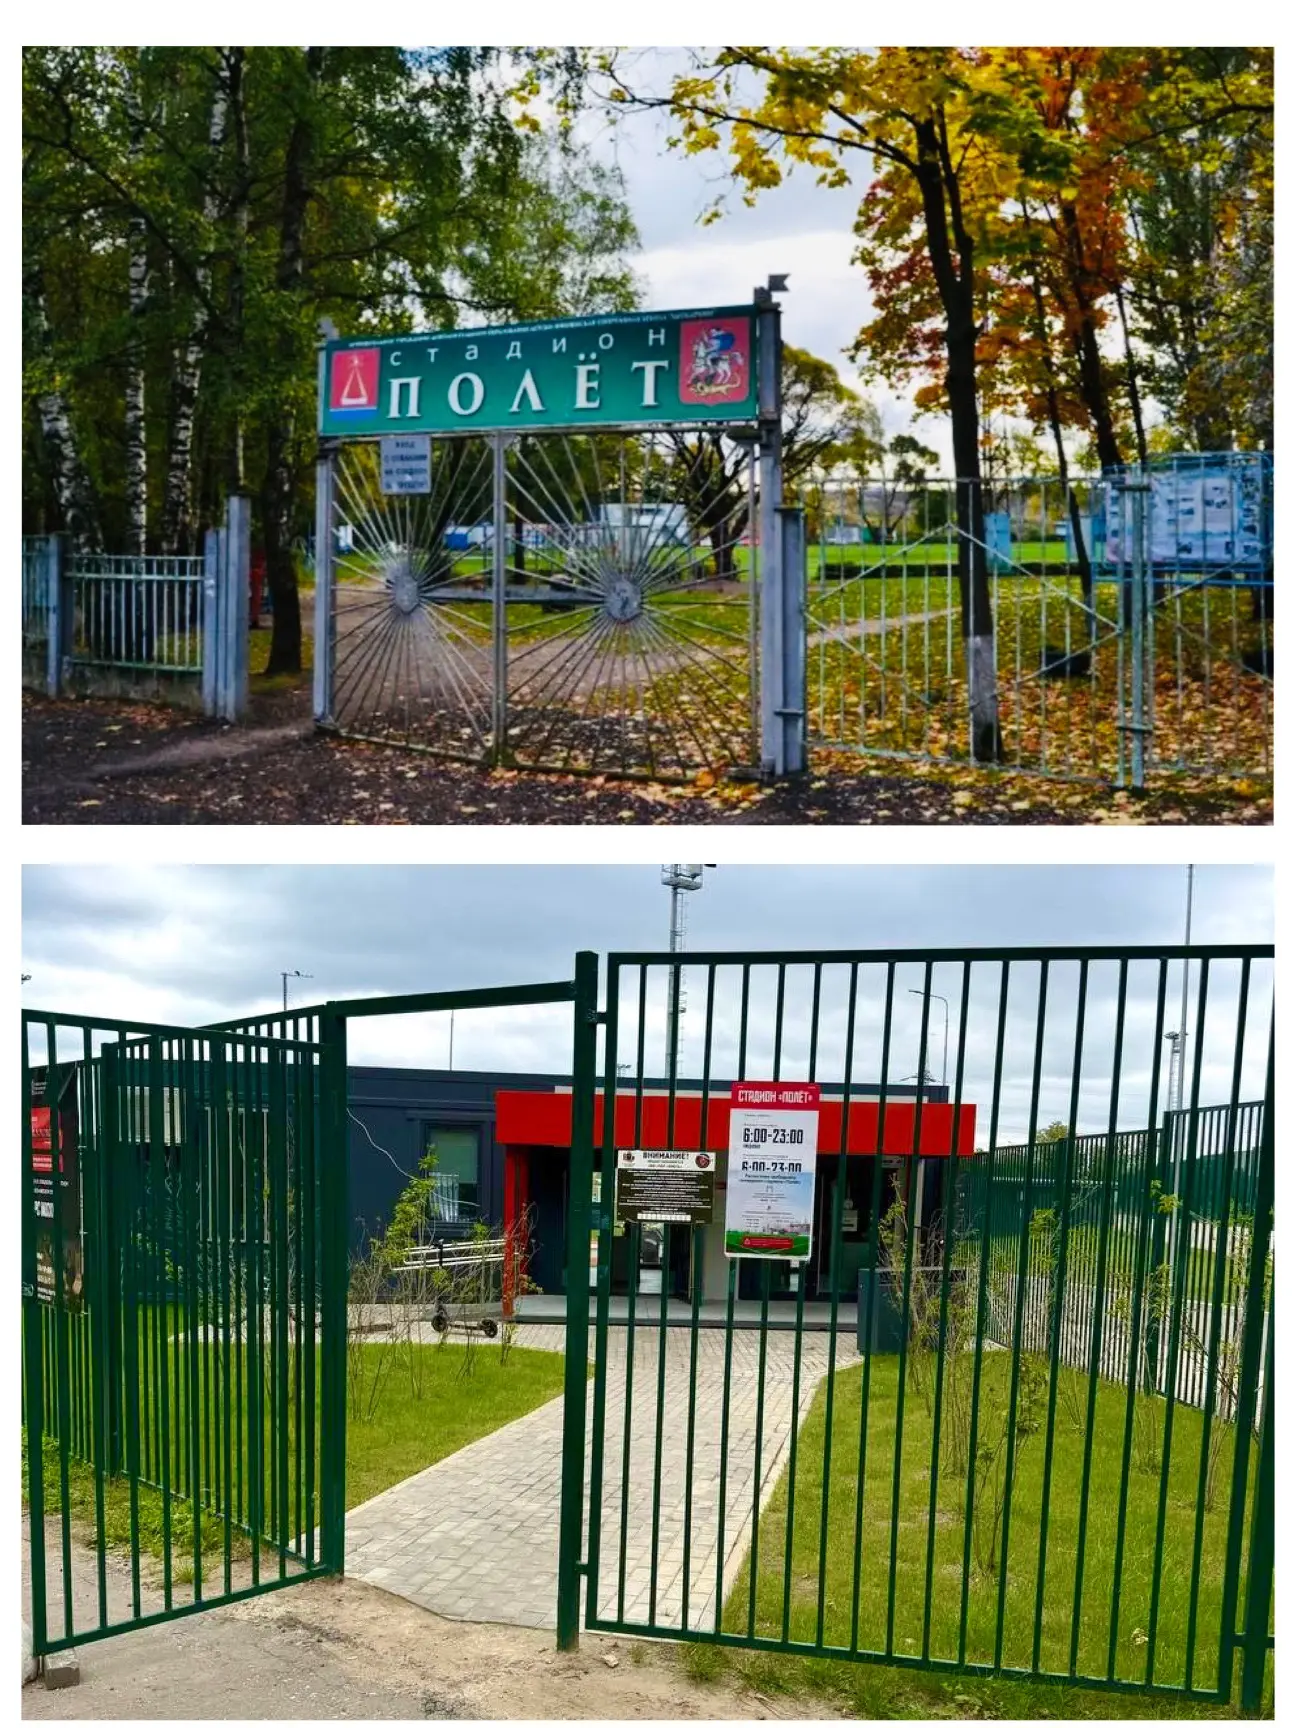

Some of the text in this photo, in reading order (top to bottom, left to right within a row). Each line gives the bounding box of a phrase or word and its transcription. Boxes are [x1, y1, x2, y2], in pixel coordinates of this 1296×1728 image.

[386, 352, 670, 420] ПОЛЁТ
[738, 1089, 777, 1104] СТАДИОН
[743, 1127, 804, 1144] 6:00-23:00
[643, 1151, 690, 1161] ВНИМАНИЕ!
